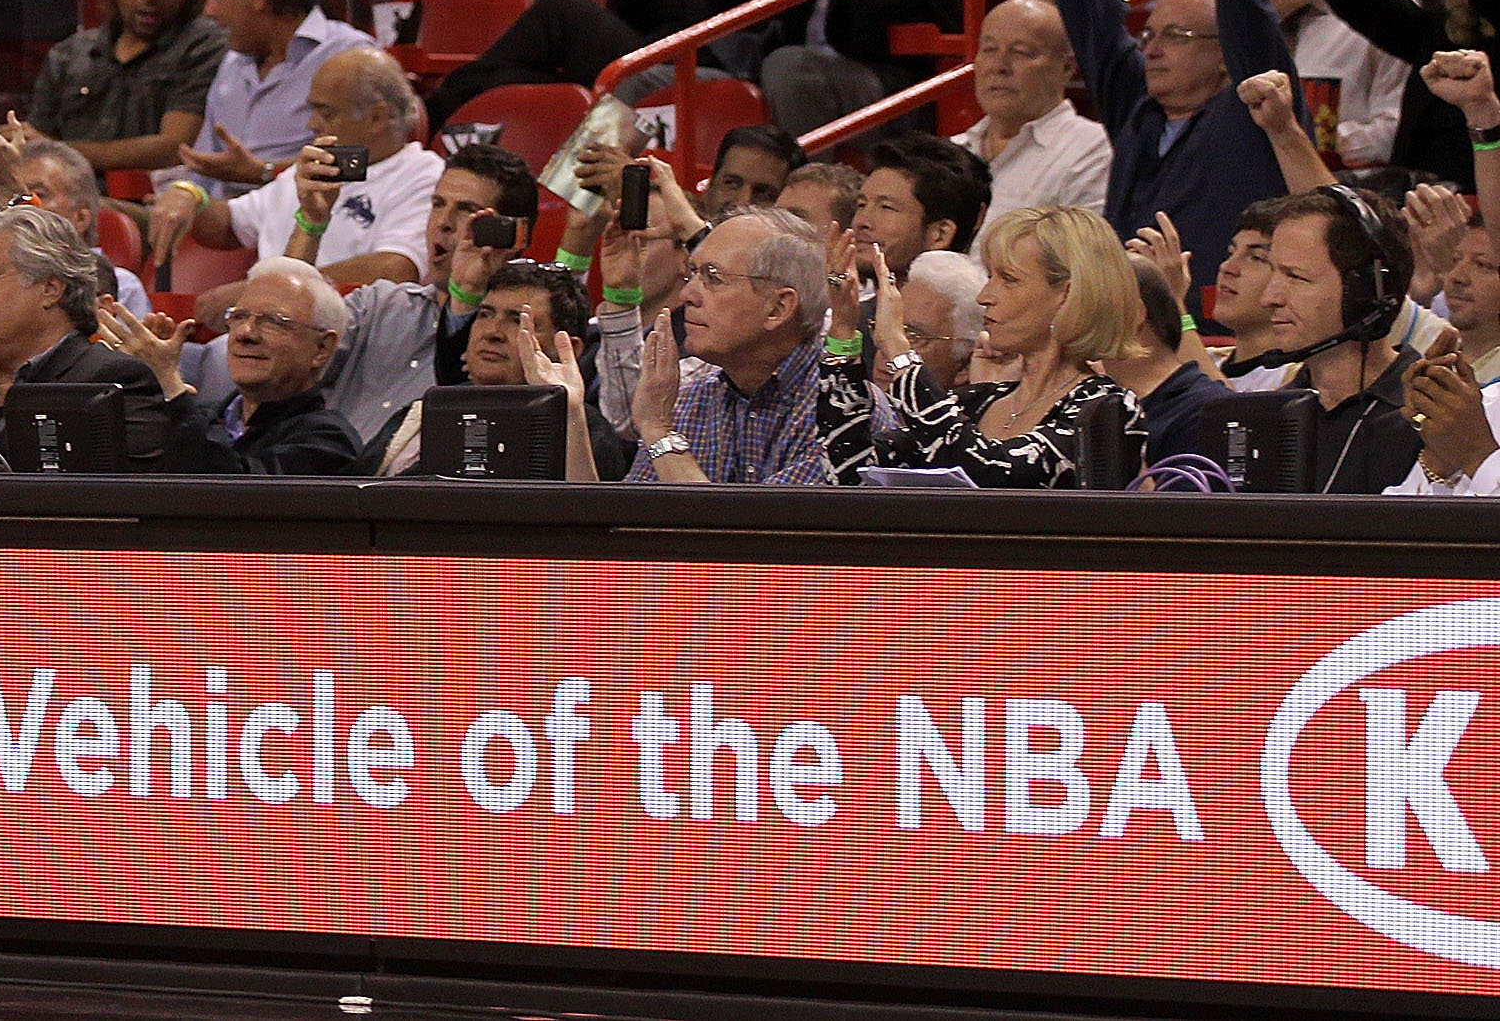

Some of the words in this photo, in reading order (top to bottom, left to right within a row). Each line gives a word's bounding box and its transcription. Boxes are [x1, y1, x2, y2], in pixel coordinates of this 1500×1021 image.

[460, 674, 592, 816] of
[630, 680, 844, 829] the
[895, 693, 1206, 843] NBA
